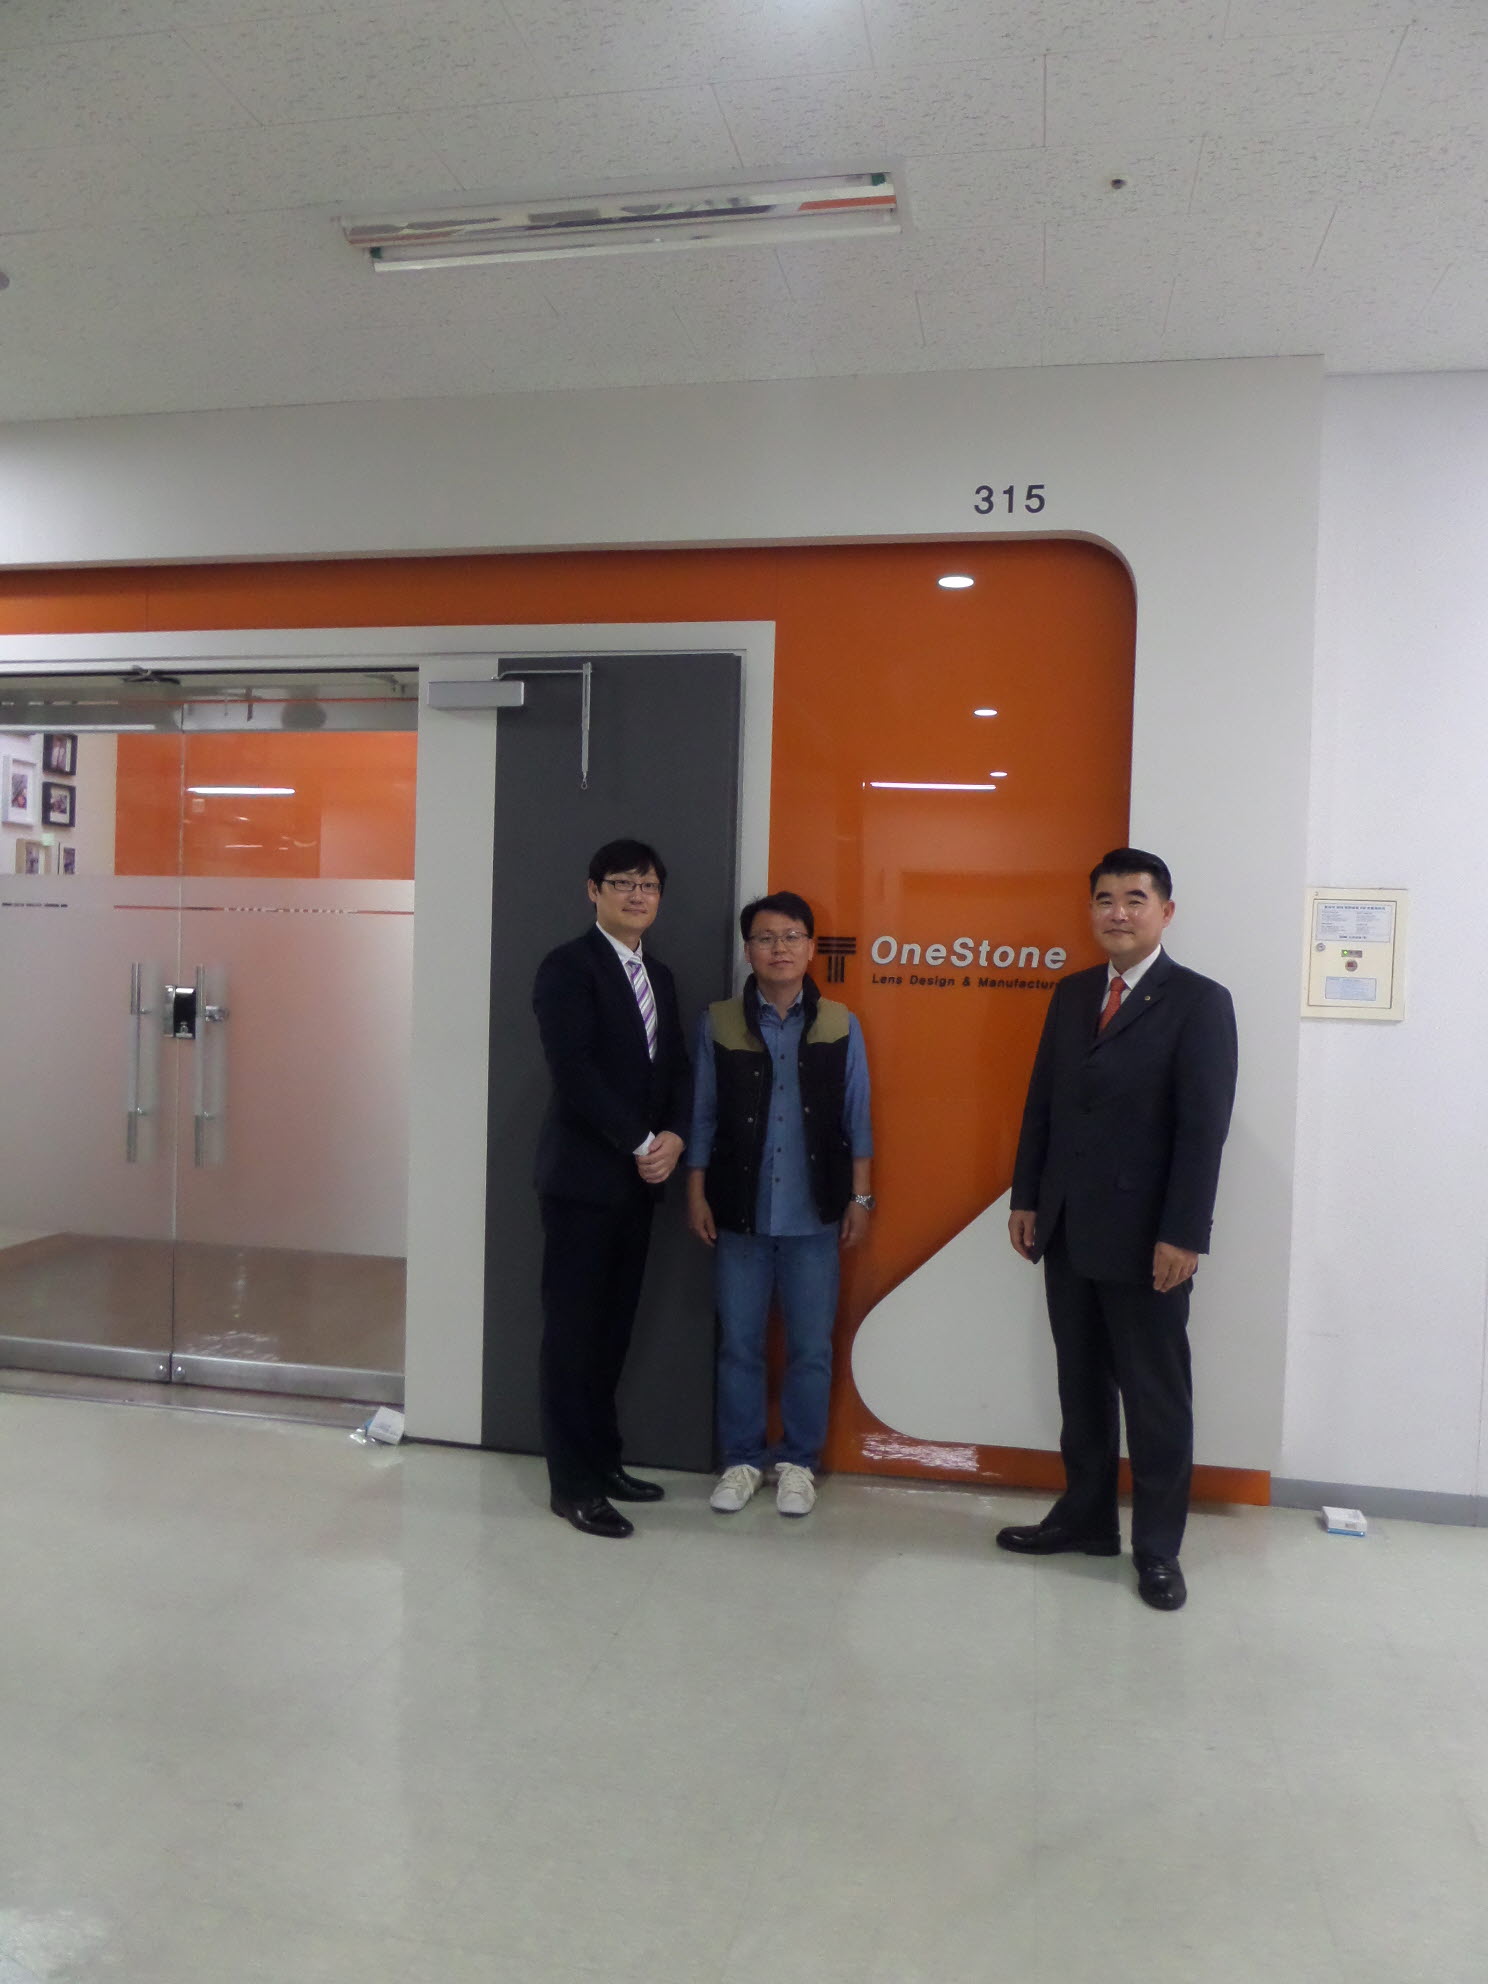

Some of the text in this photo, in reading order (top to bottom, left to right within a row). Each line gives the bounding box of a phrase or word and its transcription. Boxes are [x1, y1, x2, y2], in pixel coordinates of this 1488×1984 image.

[974, 484, 1045, 514] 315
[871, 935, 1067, 970] OneStone
[872, 973, 1058, 990] Lens Design & Manufactur
